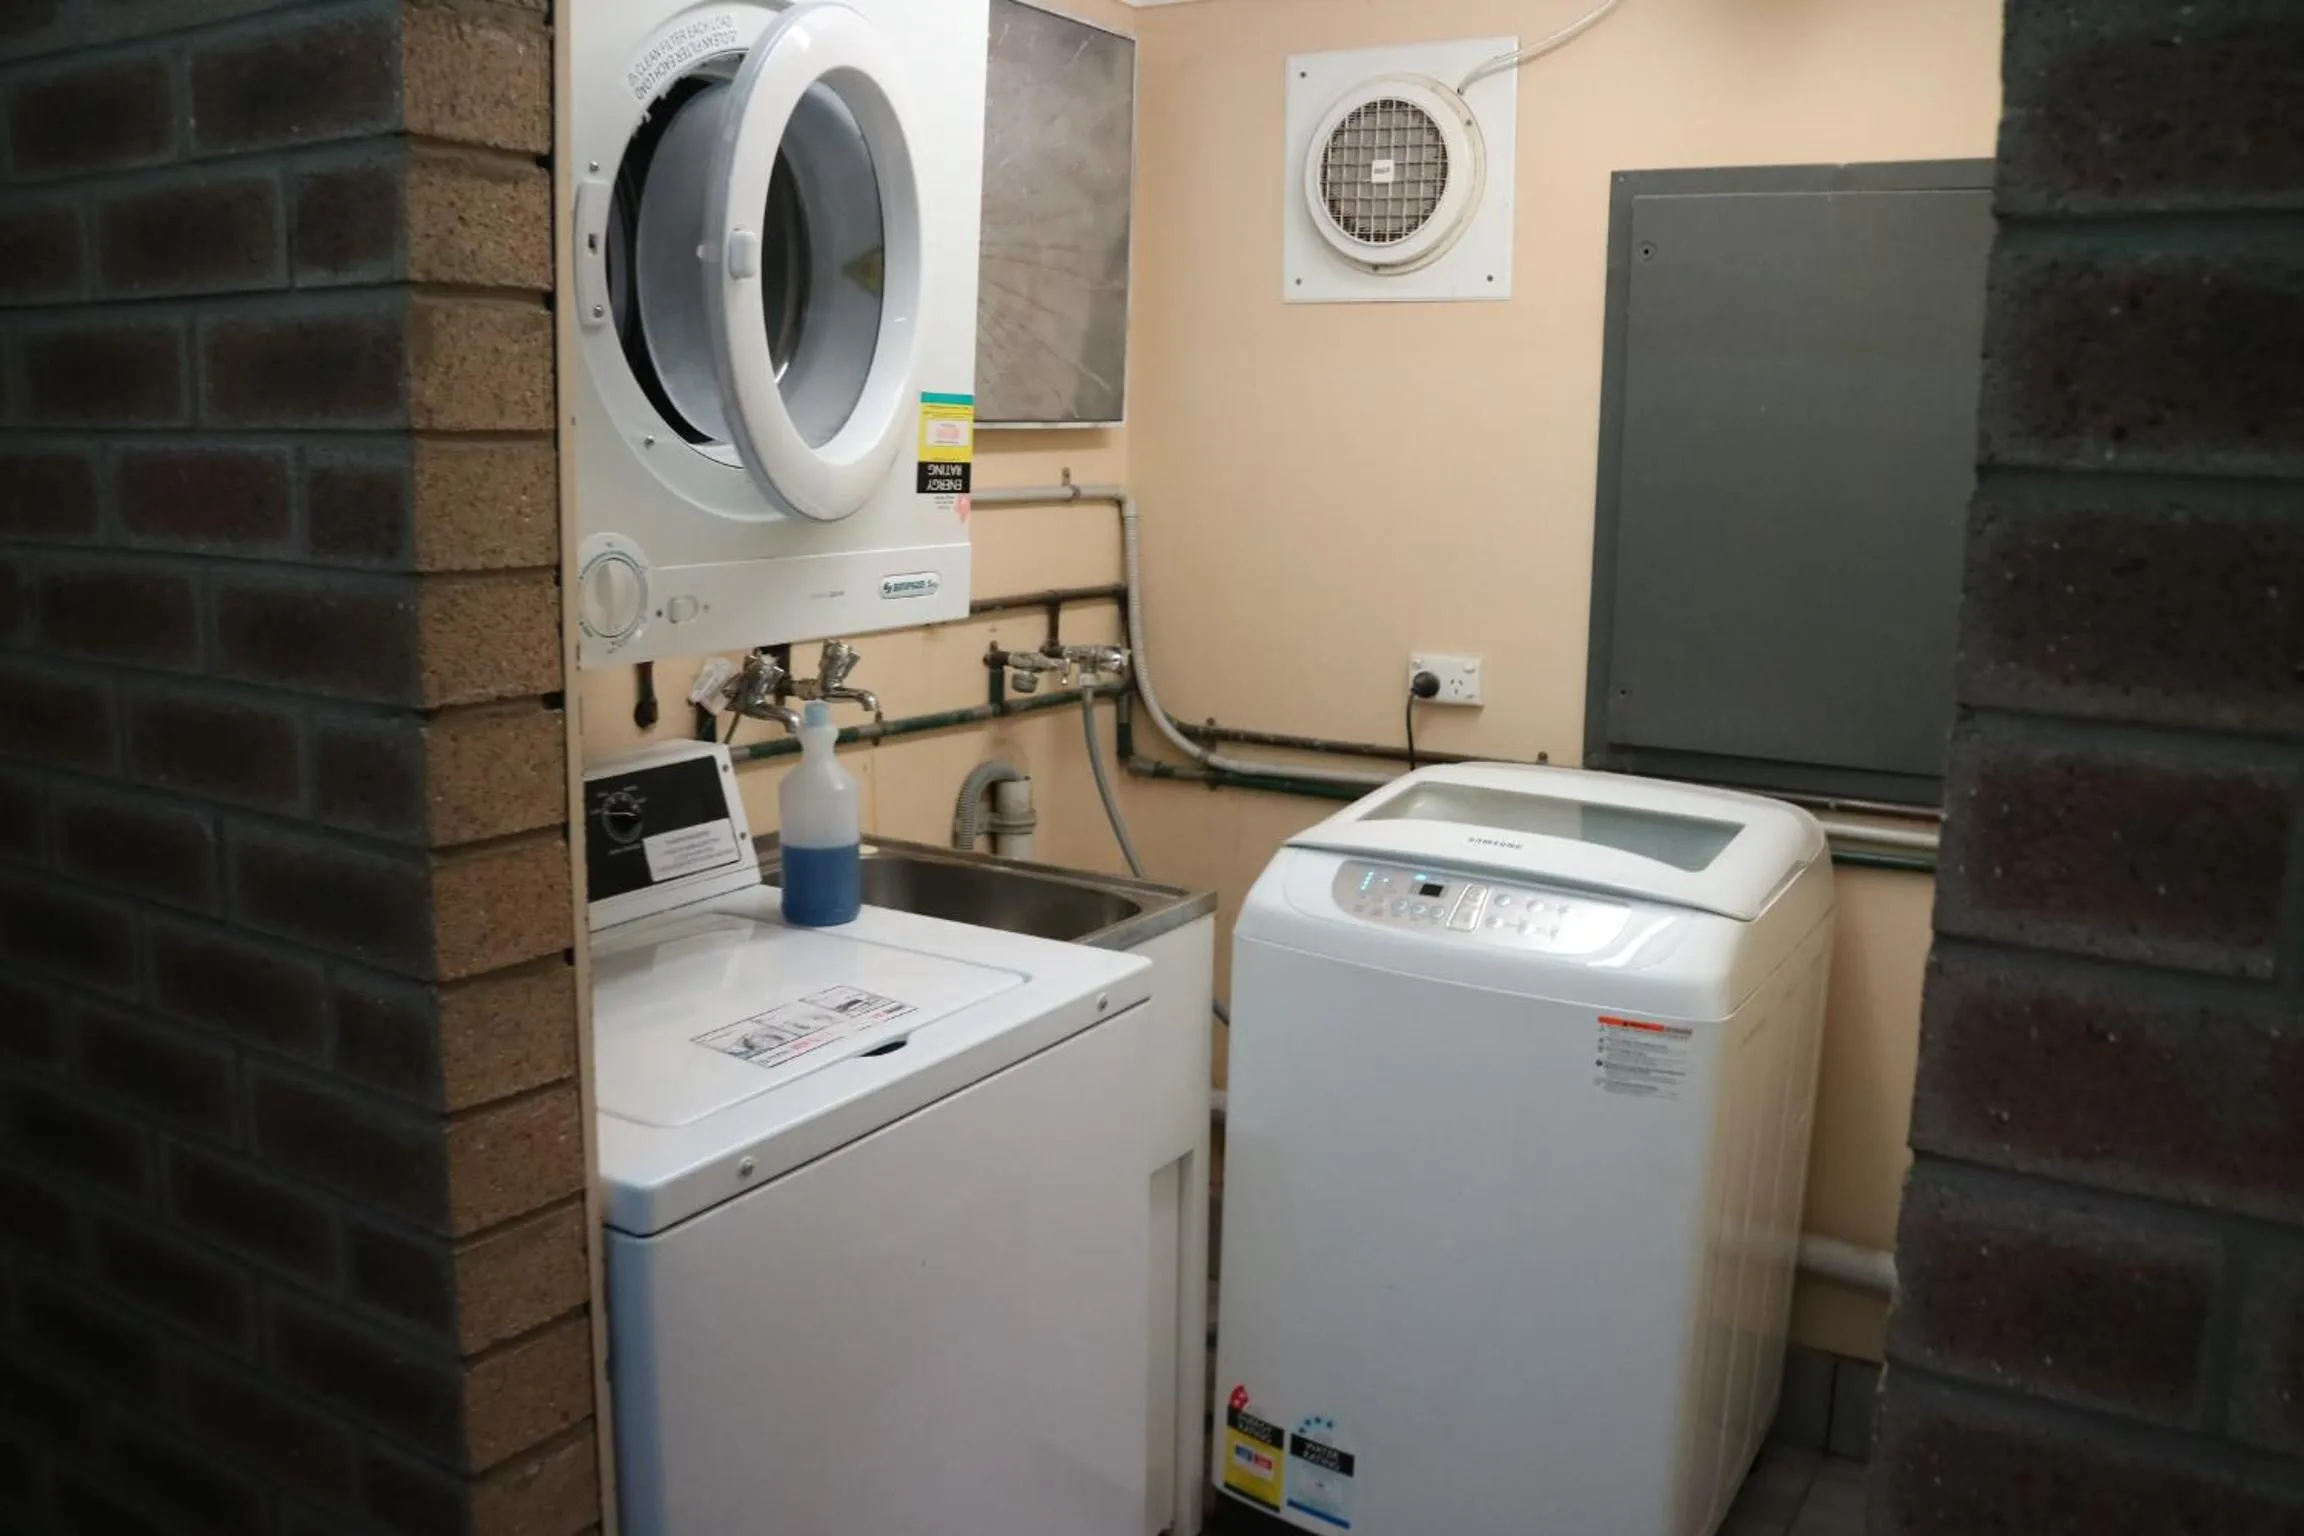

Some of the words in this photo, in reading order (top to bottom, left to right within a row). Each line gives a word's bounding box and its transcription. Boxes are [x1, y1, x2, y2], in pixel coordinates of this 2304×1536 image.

[635, 47, 662, 76] CLEAN
[660, 29, 688, 53] FILTER
[686, 21, 709, 38] EACH
[927, 464, 962, 476] RATING
[926, 479, 962, 491] ENERGY
[1305, 1441, 1338, 1459] WATER
